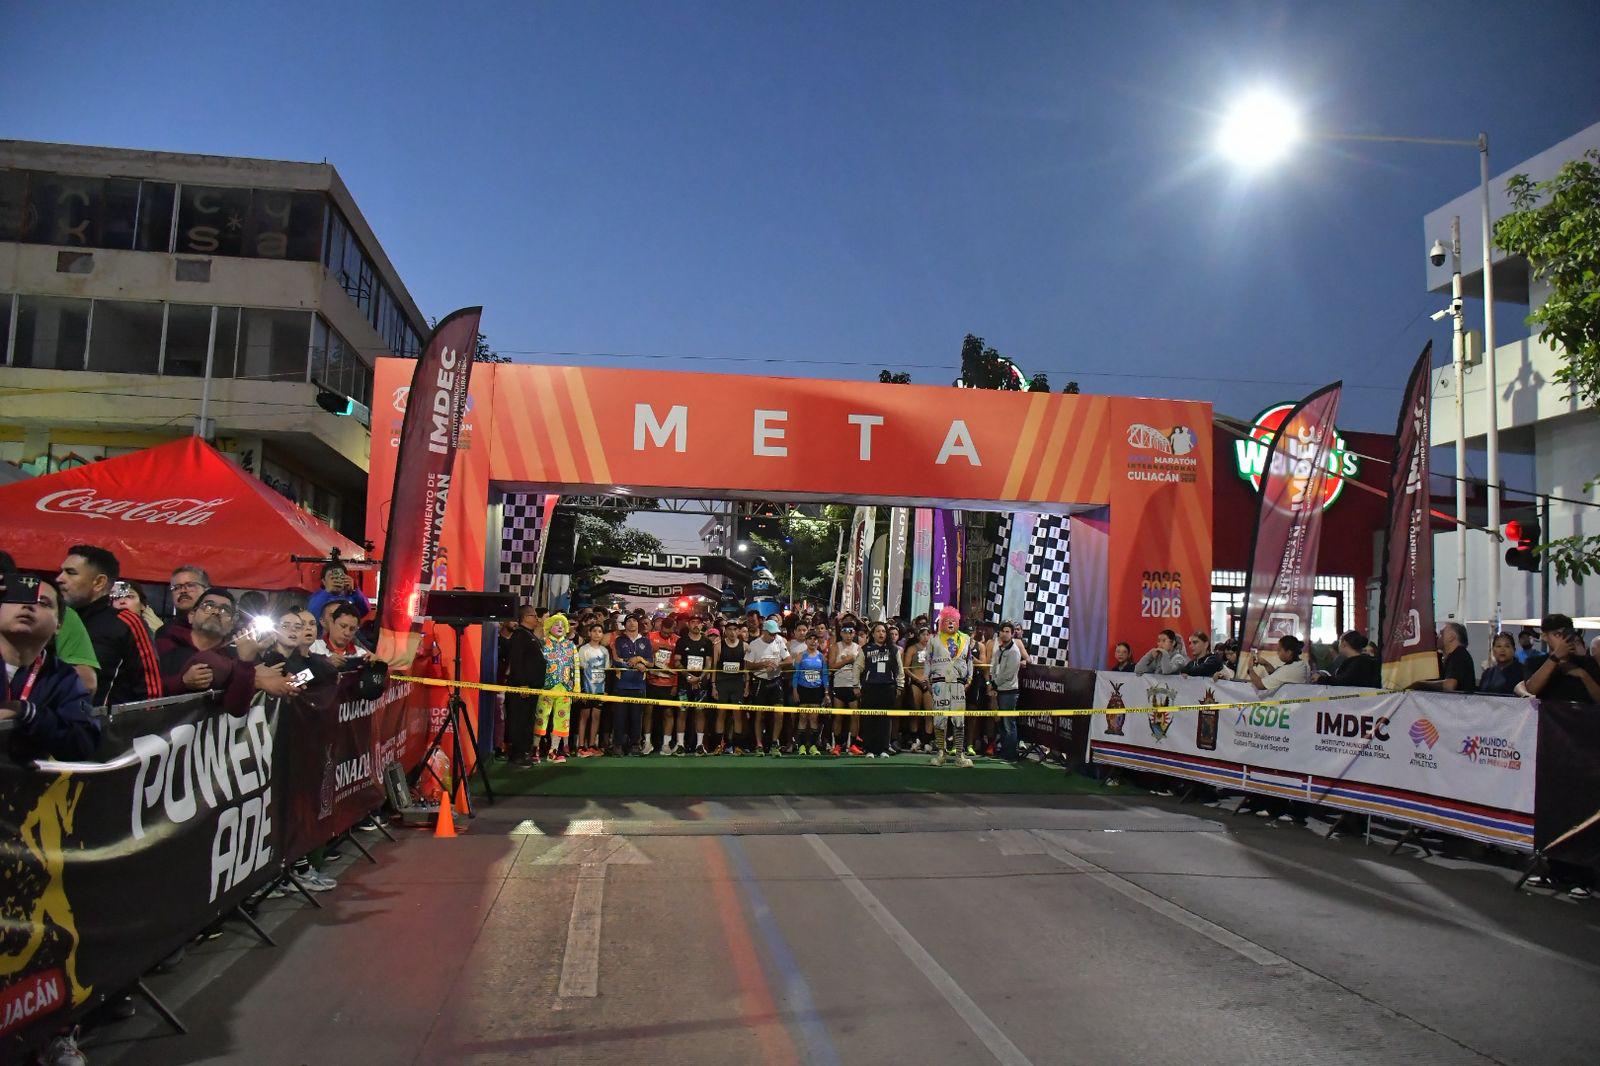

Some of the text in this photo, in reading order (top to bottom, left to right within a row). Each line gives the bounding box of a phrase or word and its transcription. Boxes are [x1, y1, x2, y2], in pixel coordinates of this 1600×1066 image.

[428, 346, 456, 454] IMDEC
[1154, 456, 1197, 466] MARATÓN
[1291, 424, 1316, 511] IMDEC
[1127, 470, 1180, 482] CULIACÁN
[36, 488, 234, 526] Coca-Cola
[421, 472, 436, 573] AYUNTAMIENTO DE
[621, 552, 701, 569] SALIDA
[628, 584, 683, 596] SALIDA
[872, 569, 882, 600] ISDE
[1141, 597, 1181, 618] 2026
[1249, 705, 1290, 730] ISDE
[1316, 711, 1391, 742] IMDEC
[1253, 731, 1281, 743] Sinaloense
[1282, 734, 1290, 743] de
[1320, 738, 1345, 747] INSTITUTO
[1374, 744, 1385, 752] DEL
[1479, 736, 1508, 748] MUNDO
[1269, 743, 1290, 753] Deporte
[1373, 750, 1391, 760] FÍSICA
[1414, 752, 1433, 761] WORLD
[1479, 748, 1521, 761] ATLETISMO
[131, 704, 274, 840] POWER
[1409, 759, 1438, 770] ATHLETICS
[208, 786, 272, 904] ADE
[0, 977, 59, 1031] IACÁN
